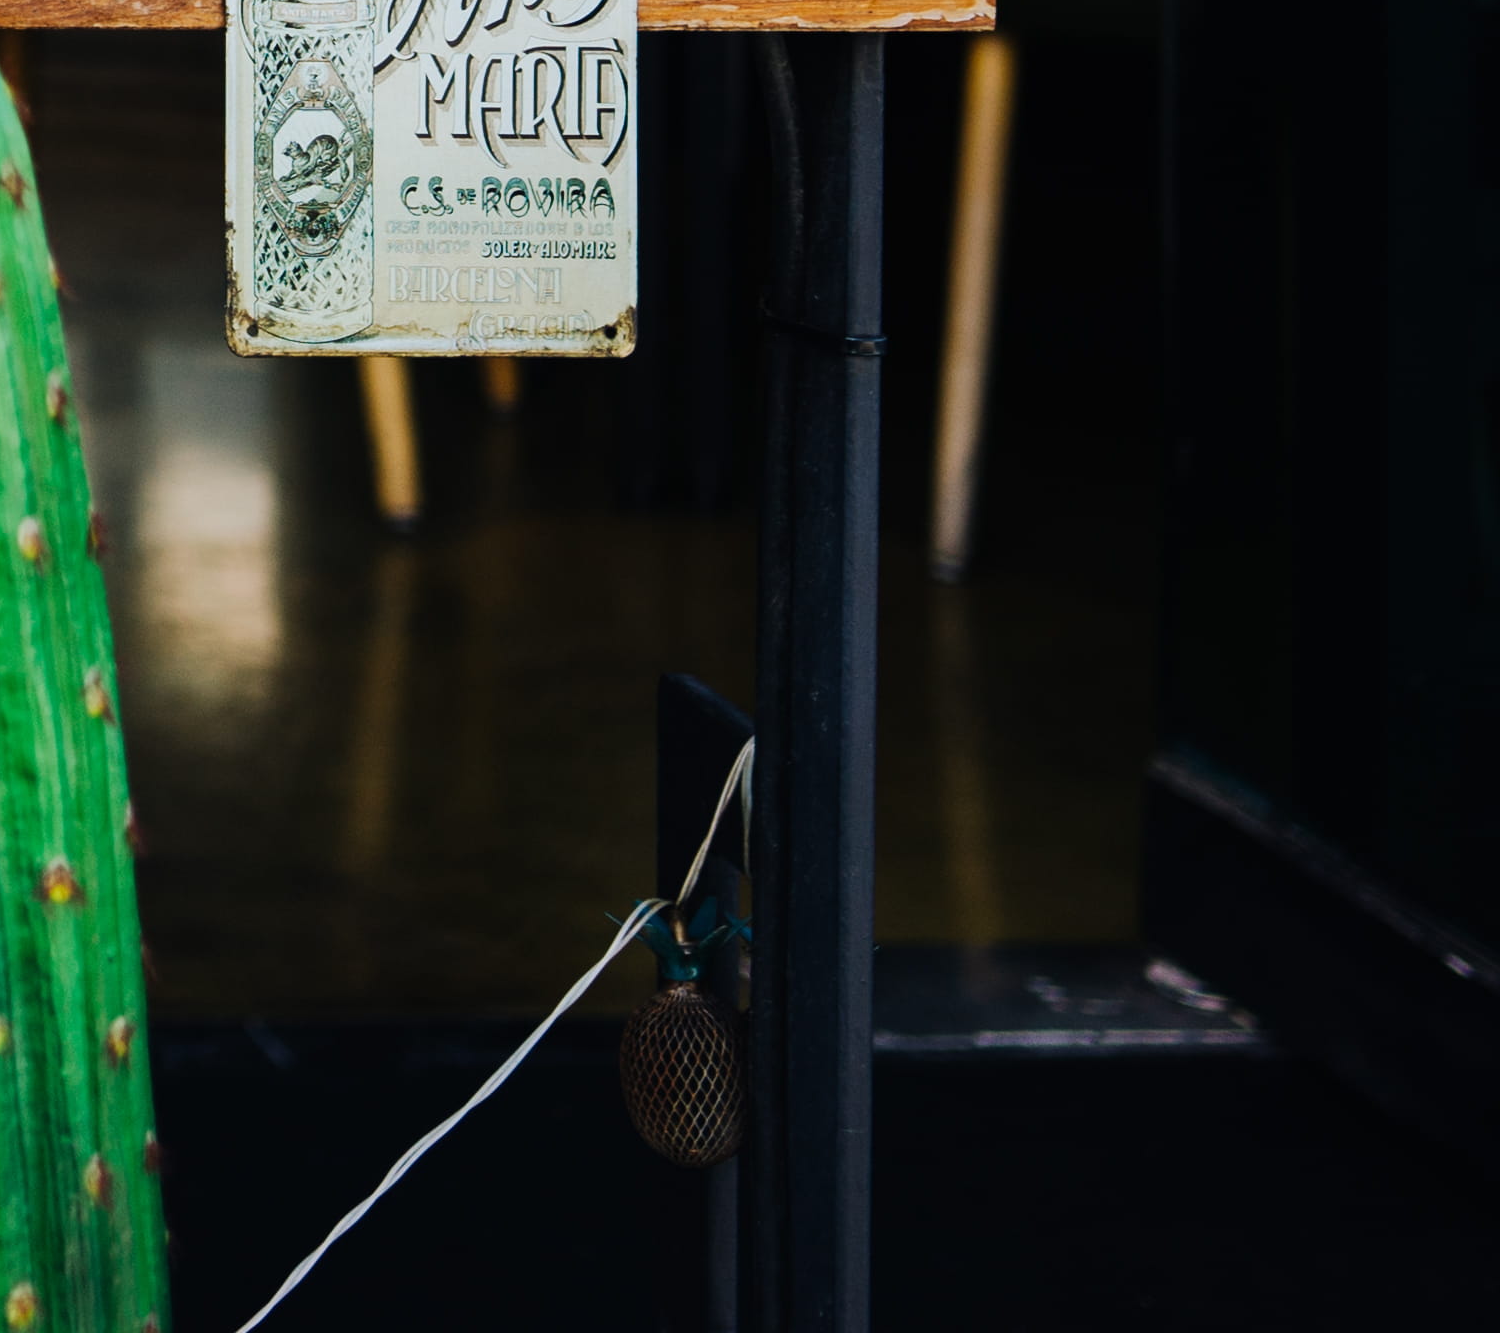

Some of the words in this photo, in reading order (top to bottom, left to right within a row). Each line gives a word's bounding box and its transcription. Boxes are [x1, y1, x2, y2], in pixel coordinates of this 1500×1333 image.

[414, 36, 630, 169] MARTA
[456, 187, 477, 205] DE
[481, 176, 616, 220] ROVIRA
[481, 239, 532, 259] SOLER
[387, 265, 563, 305] BARCELONA
